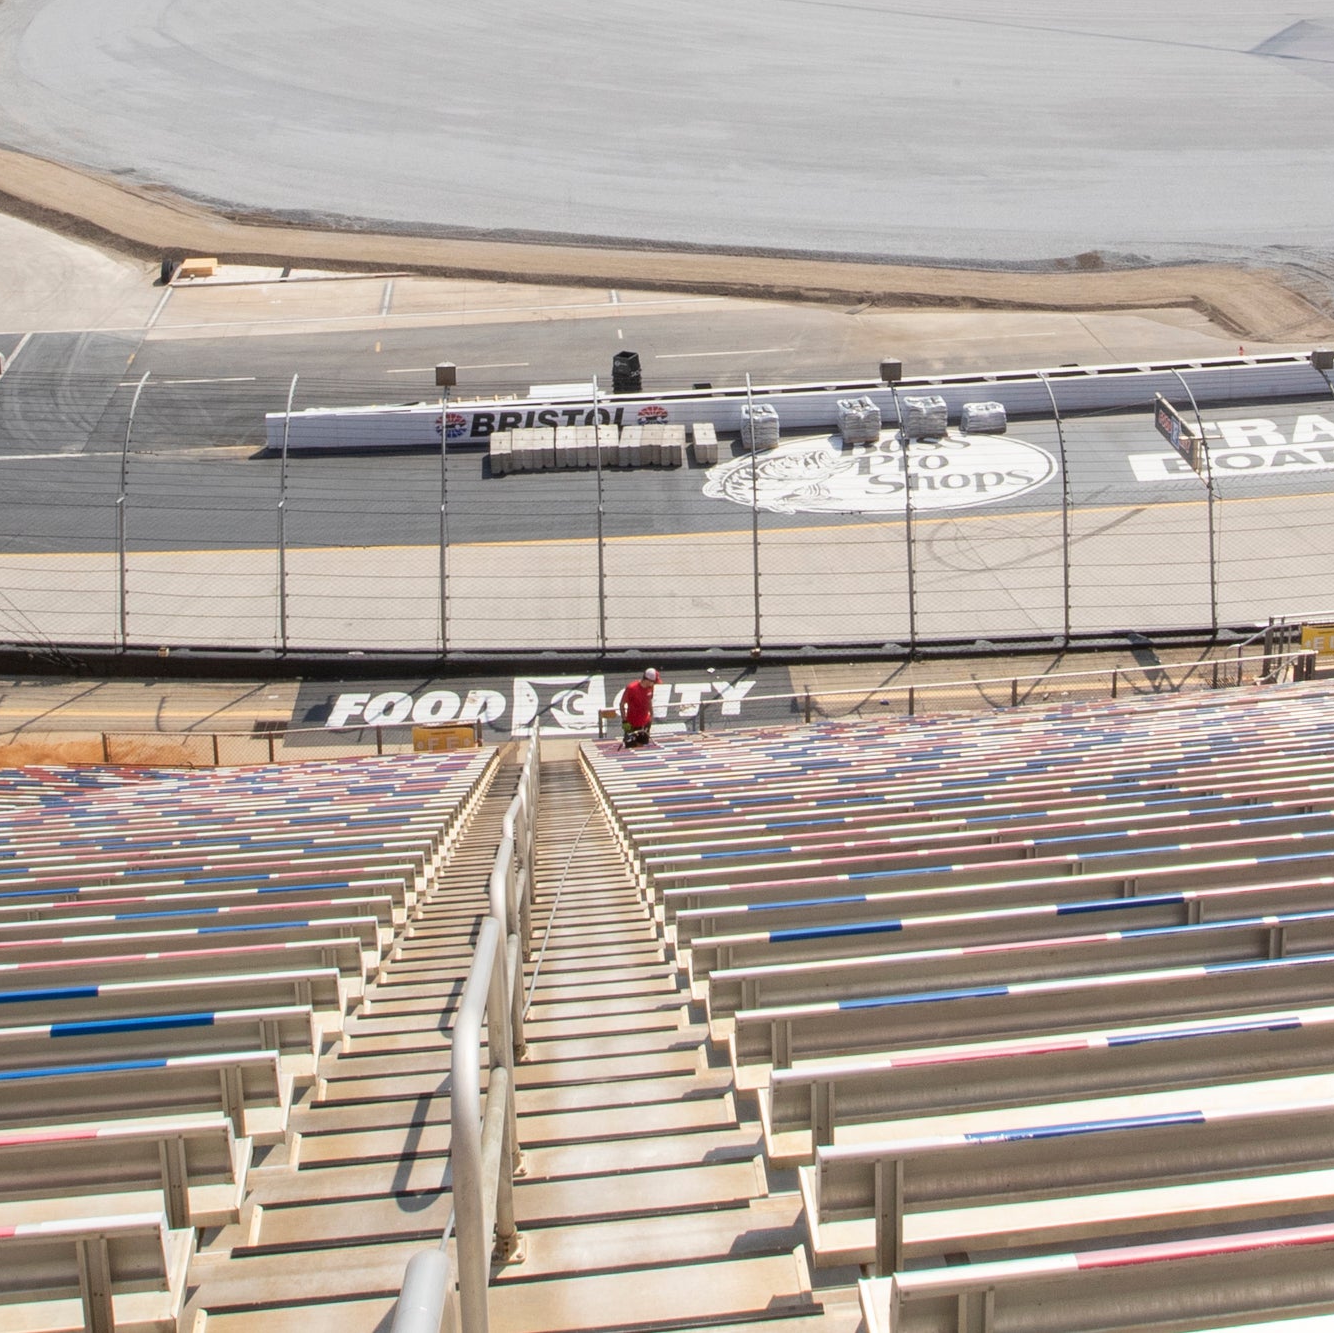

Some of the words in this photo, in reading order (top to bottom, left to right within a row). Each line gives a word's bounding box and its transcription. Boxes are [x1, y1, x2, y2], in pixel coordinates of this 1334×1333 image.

[856, 454, 949, 476] Pro
[865, 468, 1035, 495] Shops
[1314, 635, 1325, 650] E
[326, 690, 507, 728] FOOD
[613, 680, 757, 719] ITY
